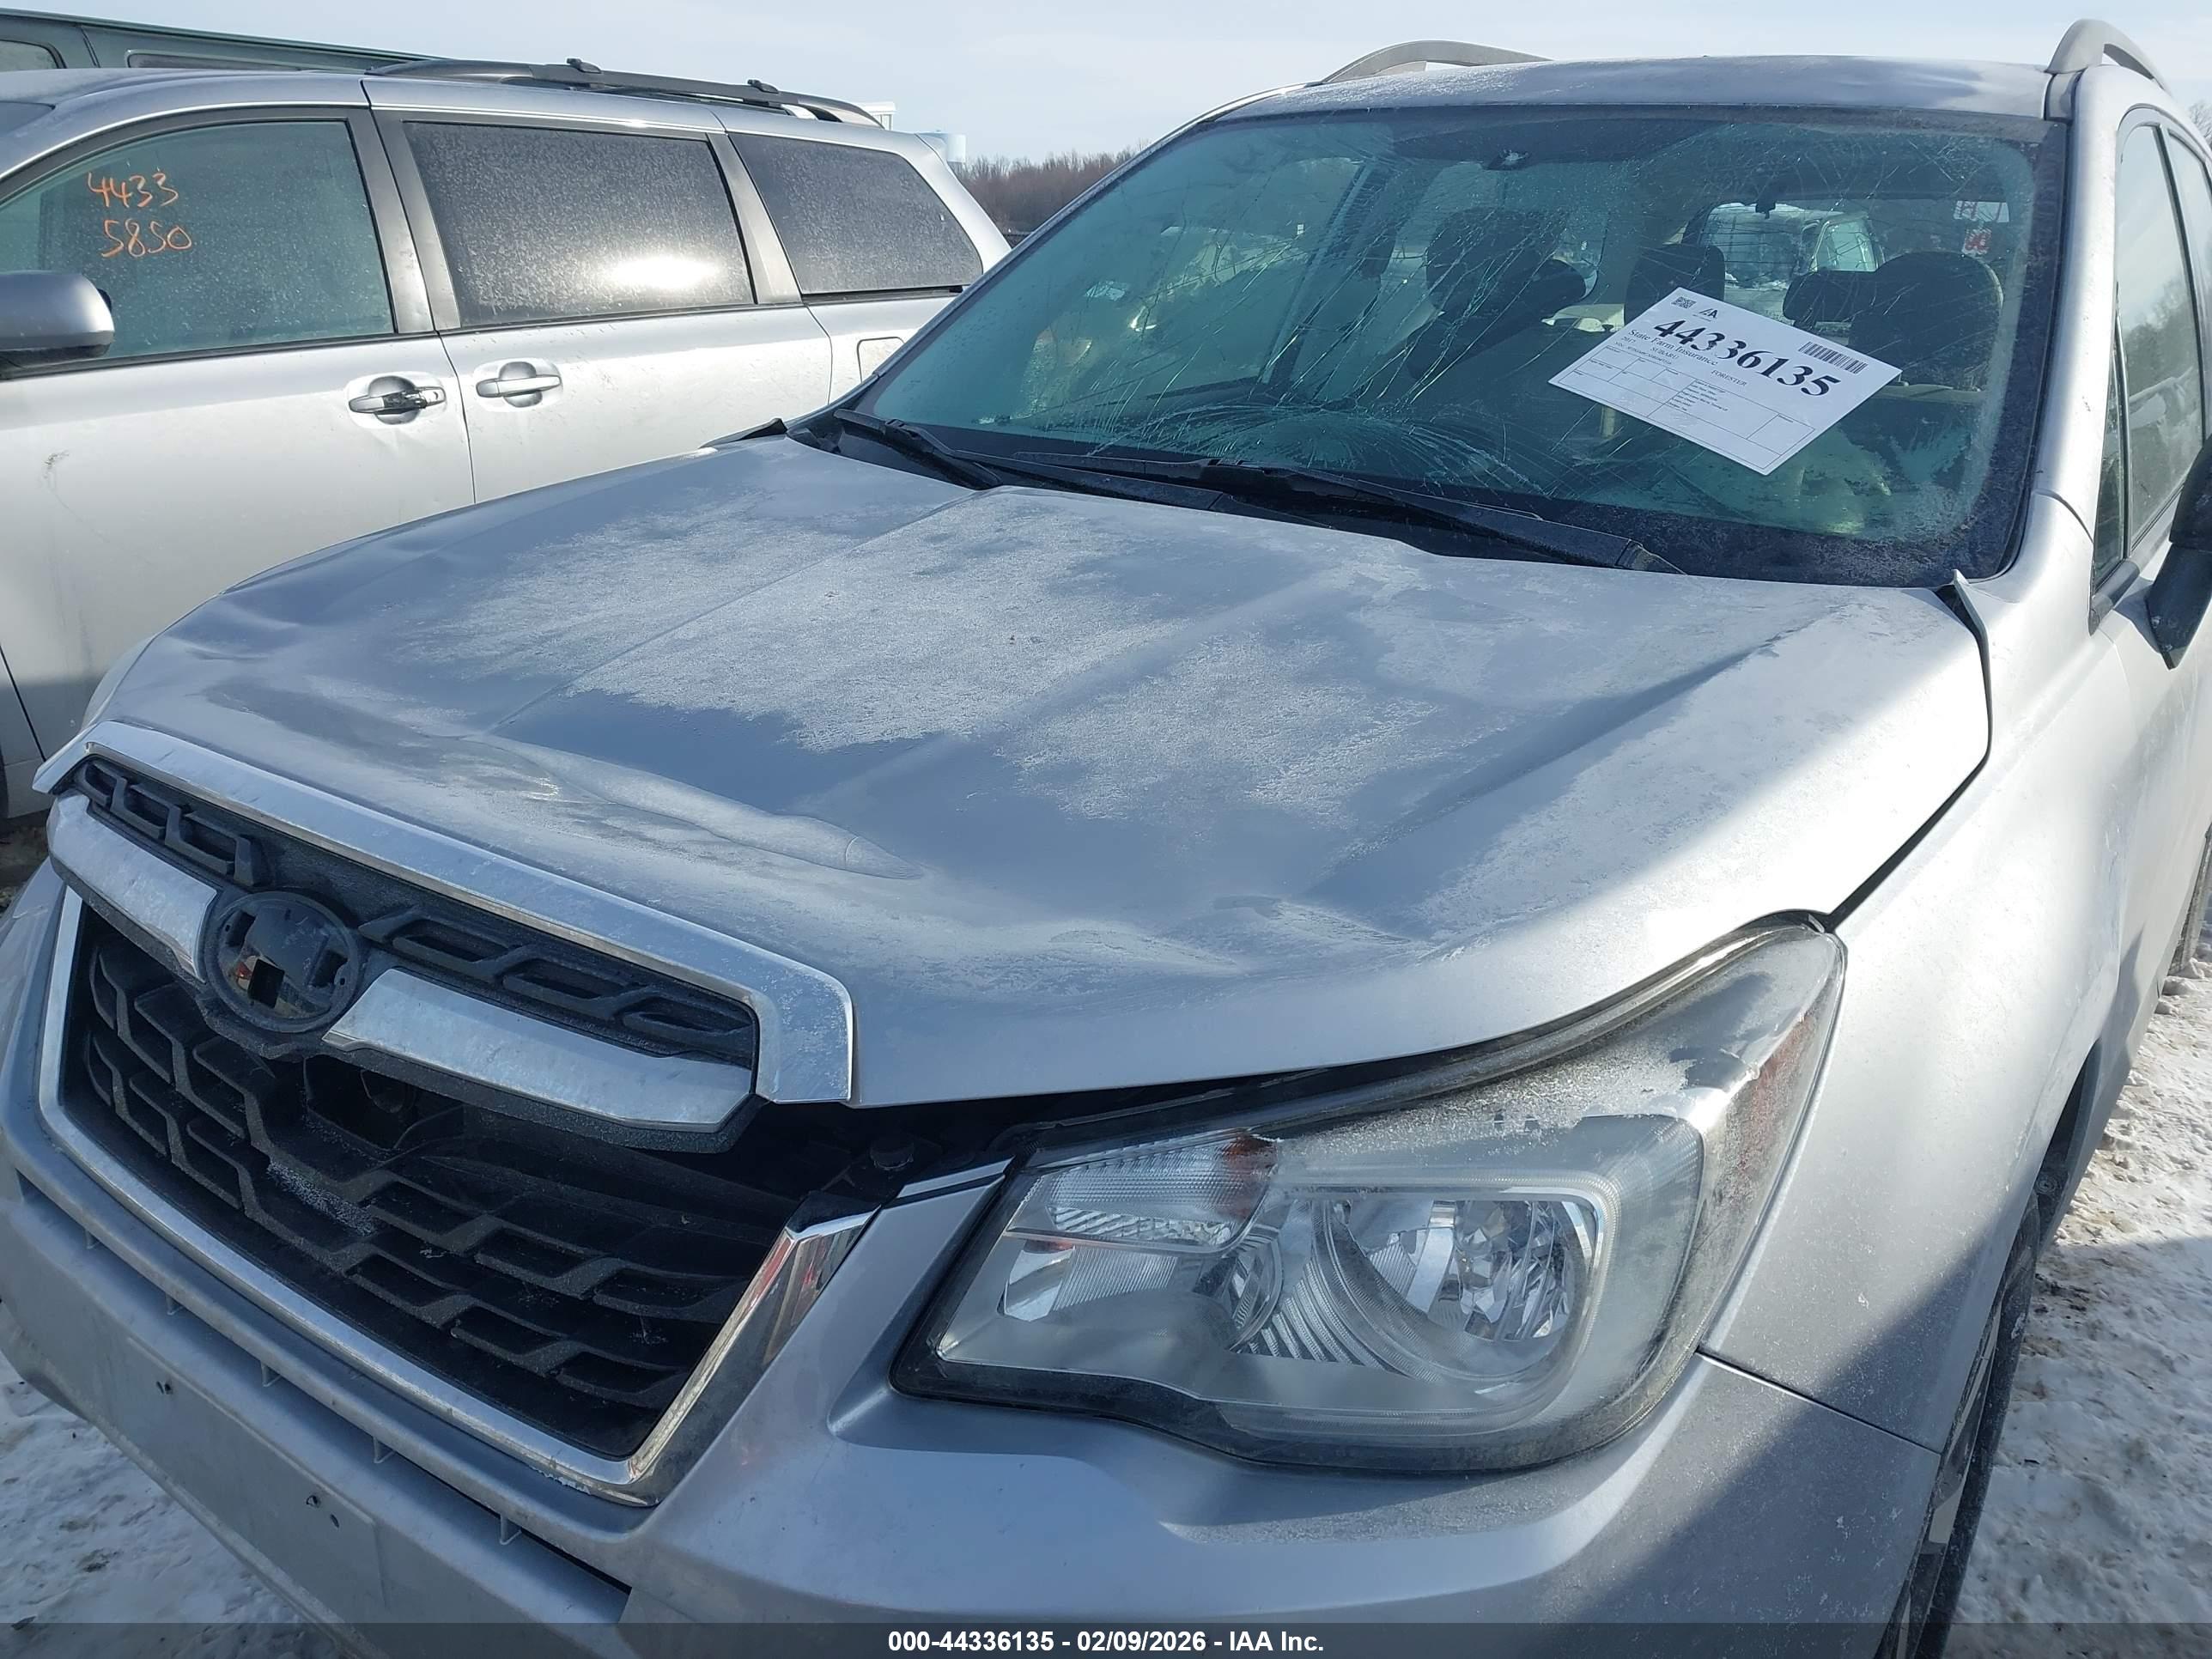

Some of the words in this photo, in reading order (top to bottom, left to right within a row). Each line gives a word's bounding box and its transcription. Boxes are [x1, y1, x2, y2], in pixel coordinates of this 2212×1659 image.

[88, 172, 179, 208] 4433
[101, 218, 192, 258] 5850
[1628, 330, 1650, 341] State
[1650, 337, 1675, 349] Farm
[1674, 345, 1718, 365] Insurance
[1654, 319, 1842, 396] 44336135
[1711, 369, 1747, 386] FORESTER
